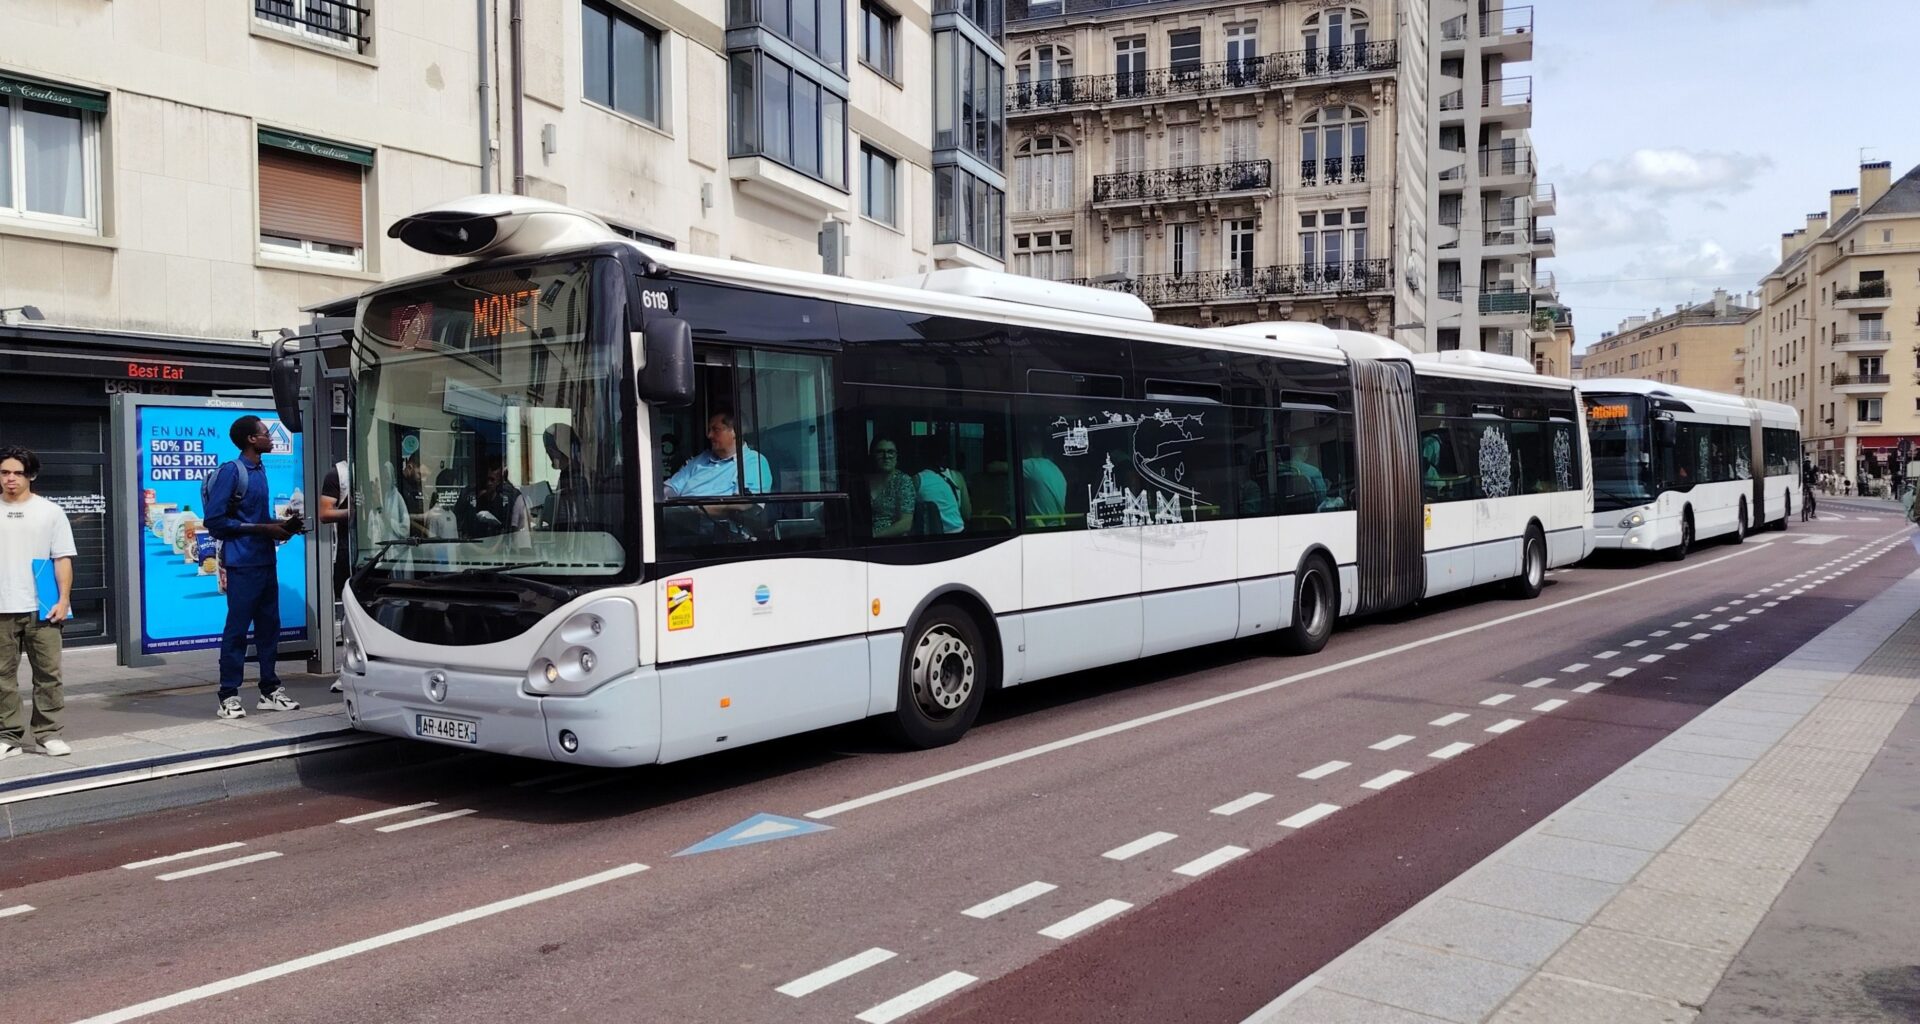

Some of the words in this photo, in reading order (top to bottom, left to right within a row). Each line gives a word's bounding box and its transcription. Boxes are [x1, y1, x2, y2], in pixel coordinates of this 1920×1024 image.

[16, 83, 73, 104] Coulisses
[286, 137, 305, 151] Les
[307, 142, 349, 159] Coulisses
[642, 289, 669, 310] 6119
[473, 288, 542, 338] MONET
[128, 363, 159, 378] Best
[162, 365, 185, 380] Eat
[205, 399, 244, 408] JCDecaux
[151, 426, 170, 437] EN
[175, 426, 193, 437] UN
[198, 426, 220, 439] AN,
[152, 440, 180, 452] 50%
[183, 440, 202, 452] DE
[152, 454, 181, 466] NOS
[184, 454, 217, 466] PRIX
[152, 469, 181, 481] ONT
